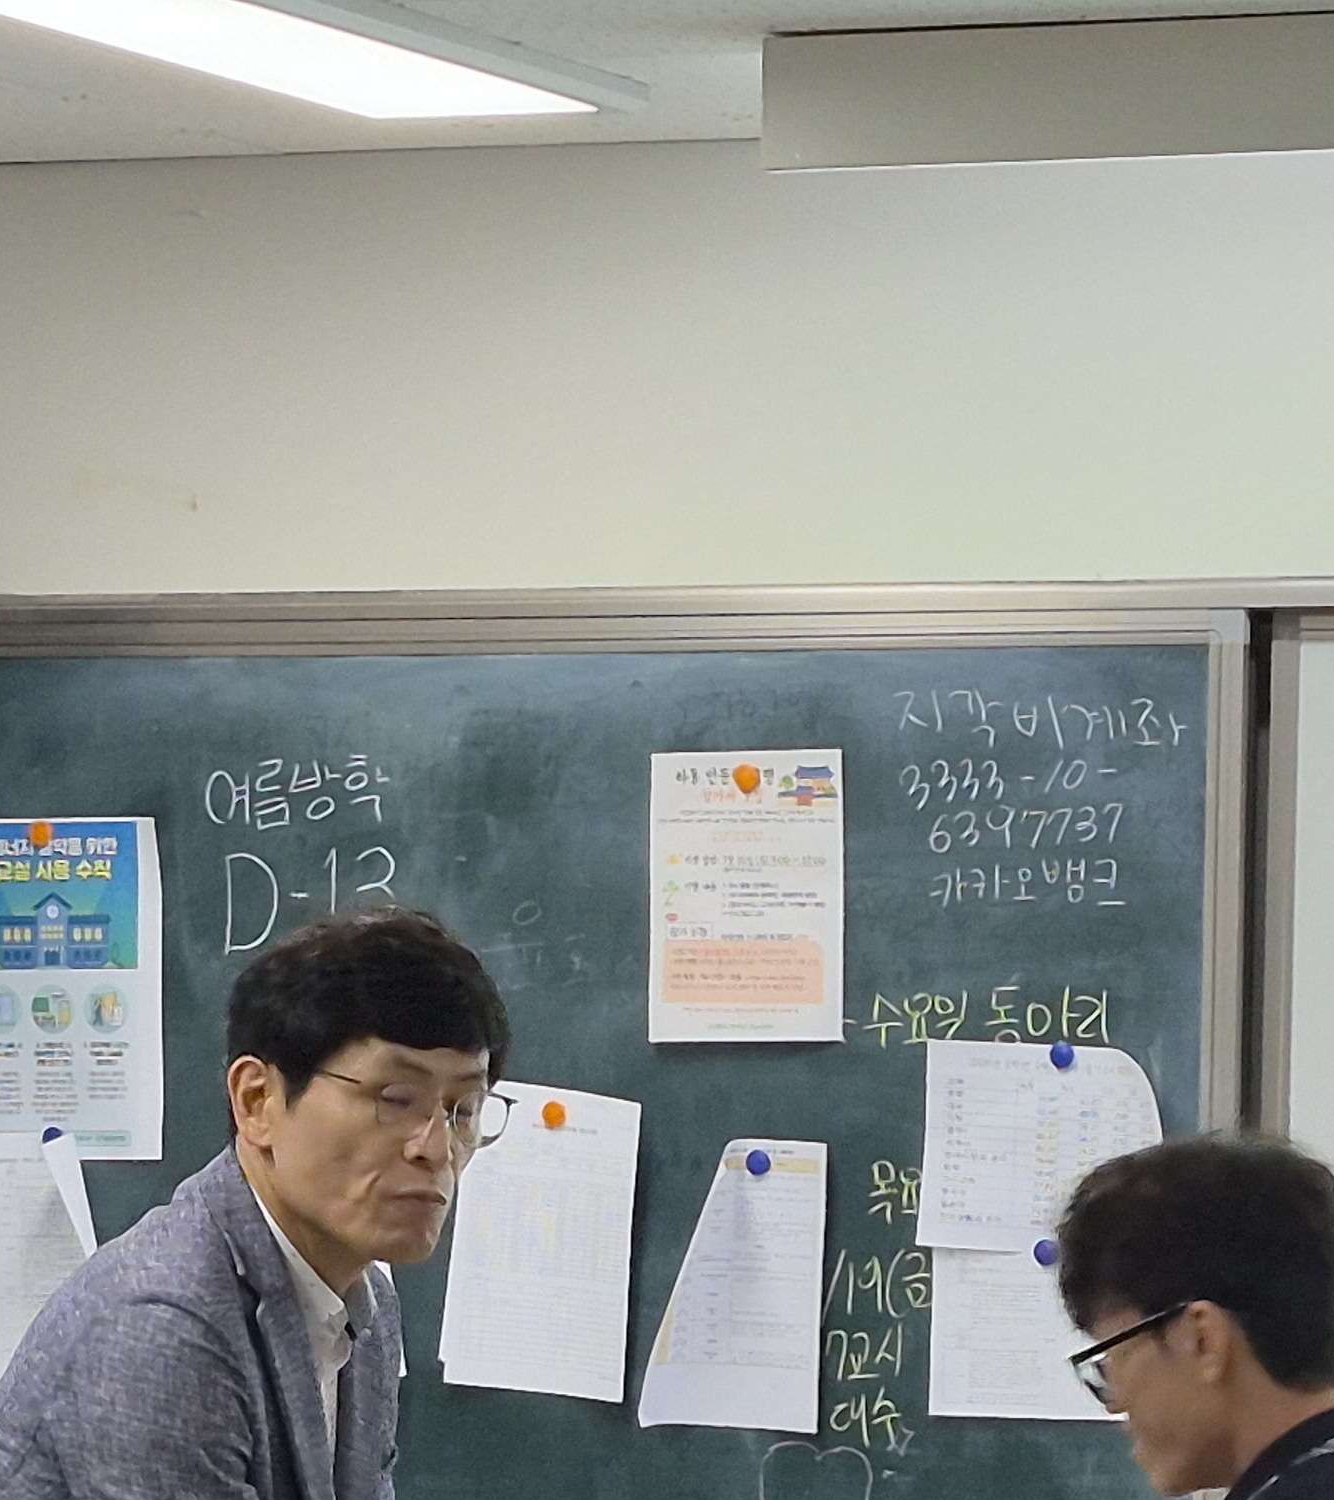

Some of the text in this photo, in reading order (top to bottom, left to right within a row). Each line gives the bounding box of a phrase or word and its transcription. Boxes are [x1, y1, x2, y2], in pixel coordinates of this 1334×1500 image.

[205, 754, 390, 830] 여름방학
[929, 803, 1123, 852] 6397737
[930, 858, 1126, 907] 카카오뱅크
[984, 985, 1108, 1043] 동아리
